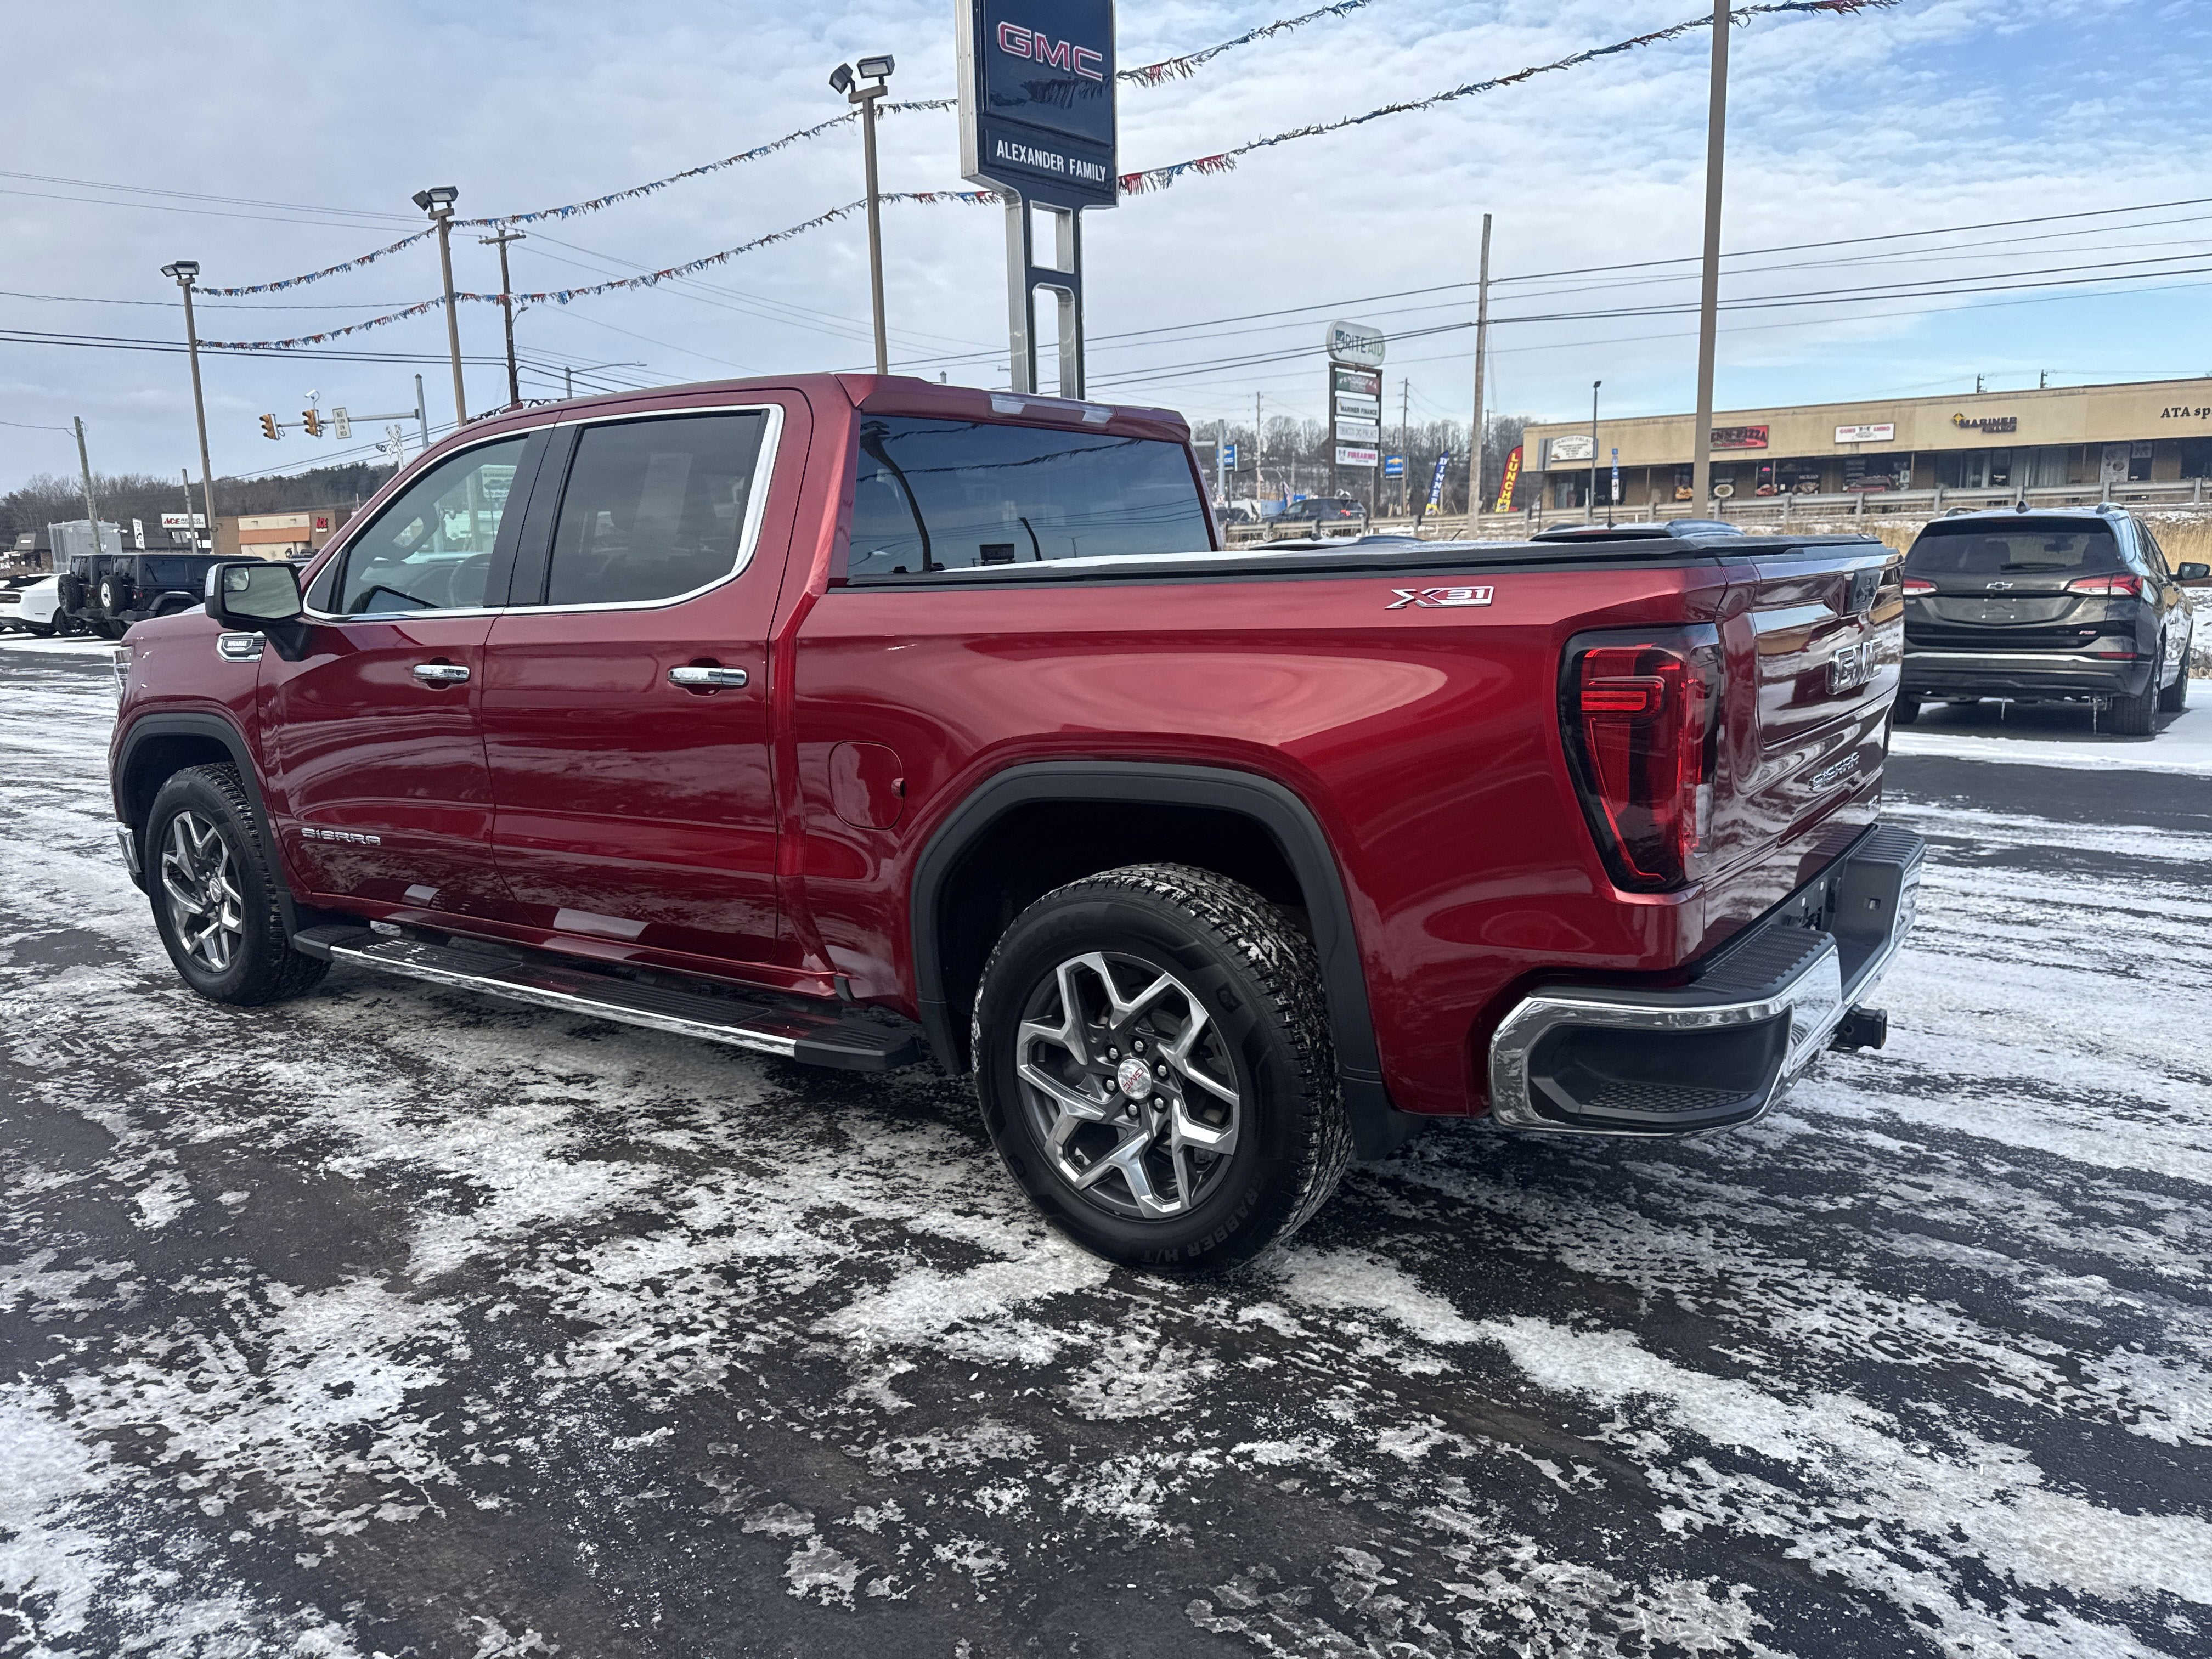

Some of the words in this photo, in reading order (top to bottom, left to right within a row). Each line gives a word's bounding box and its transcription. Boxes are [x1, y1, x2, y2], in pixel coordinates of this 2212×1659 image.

[998, 21, 1103, 81] GMC
[996, 140, 1064, 173] ALEXANDER
[1069, 158, 1106, 182] FAMILY
[1345, 333, 1366, 353] RITE
[1959, 417, 2017, 428] MARINER
[2160, 407, 2191, 418] ATA
[1347, 451, 1376, 460] FIREARMS
[1430, 457, 1448, 505] DINNER
[1502, 453, 1519, 500] LUNCH
[1384, 586, 1494, 609] X31
[301, 828, 381, 846] SIERRA
[1122, 1067, 1144, 1092] GMC
